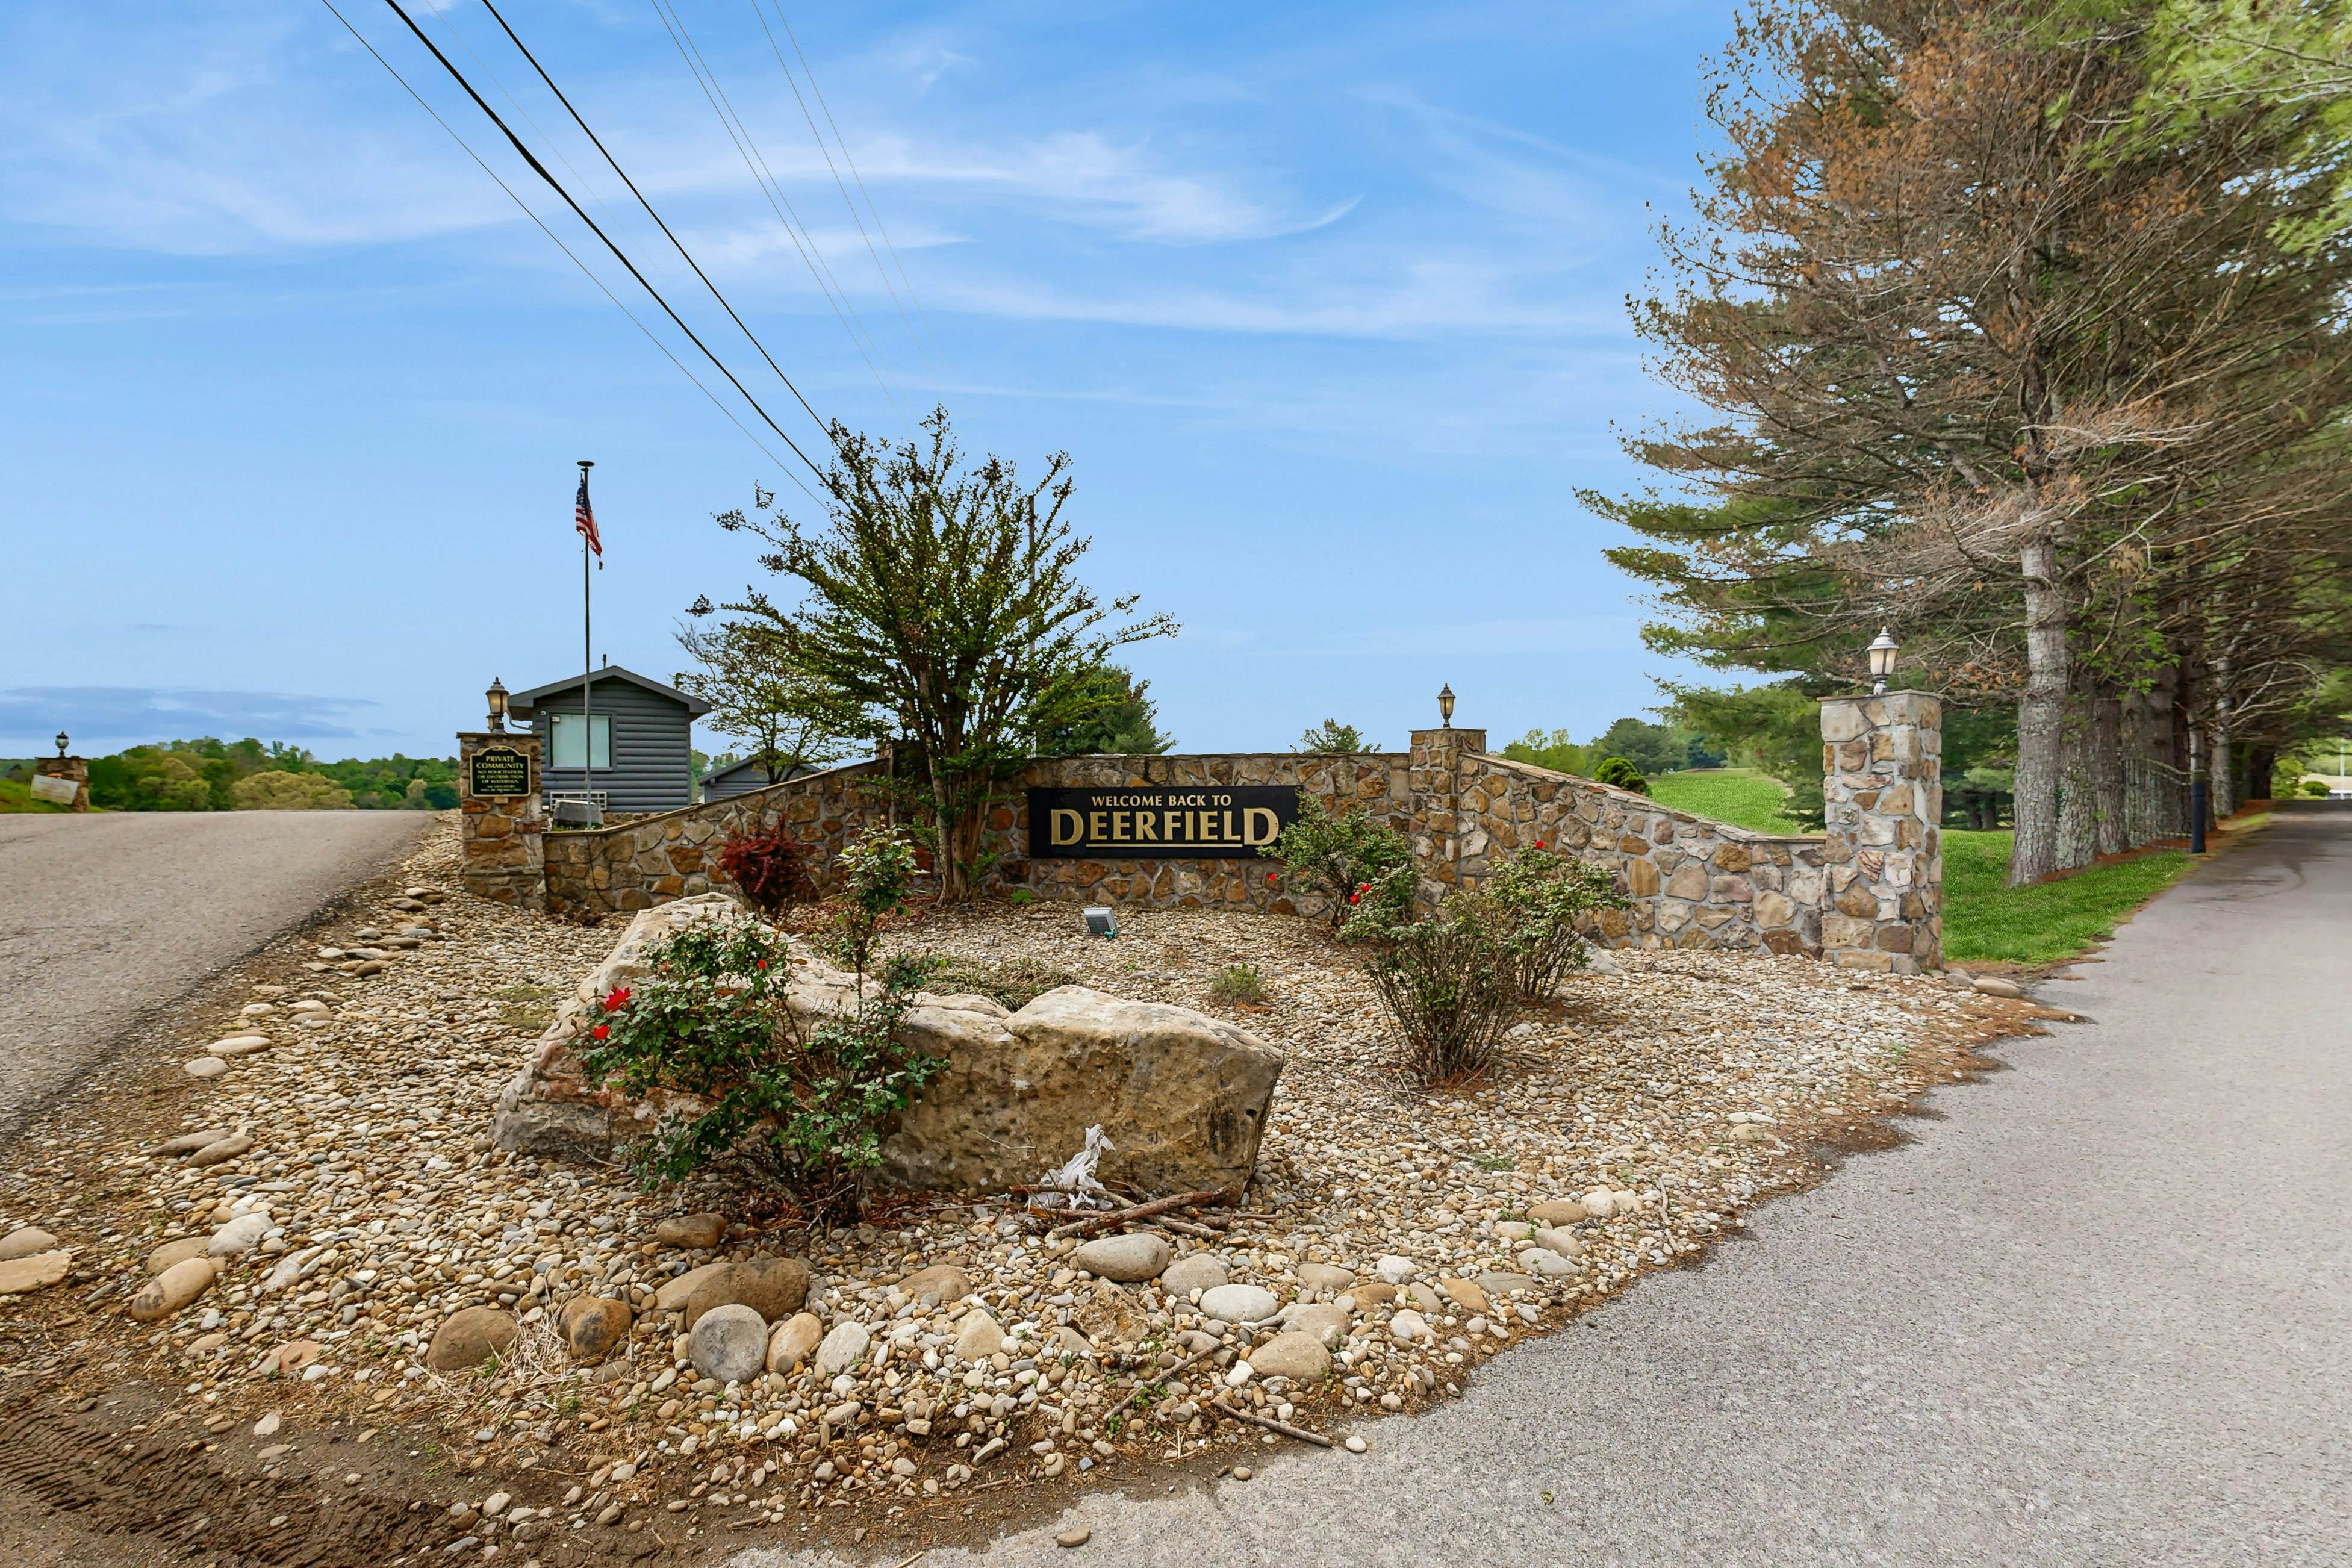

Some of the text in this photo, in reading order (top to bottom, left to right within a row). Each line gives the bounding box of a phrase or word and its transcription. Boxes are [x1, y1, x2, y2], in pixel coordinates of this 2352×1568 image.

[1092, 795, 1232, 807] WELCOME BACK TO
[1050, 807, 1280, 846] DEERFIELD
